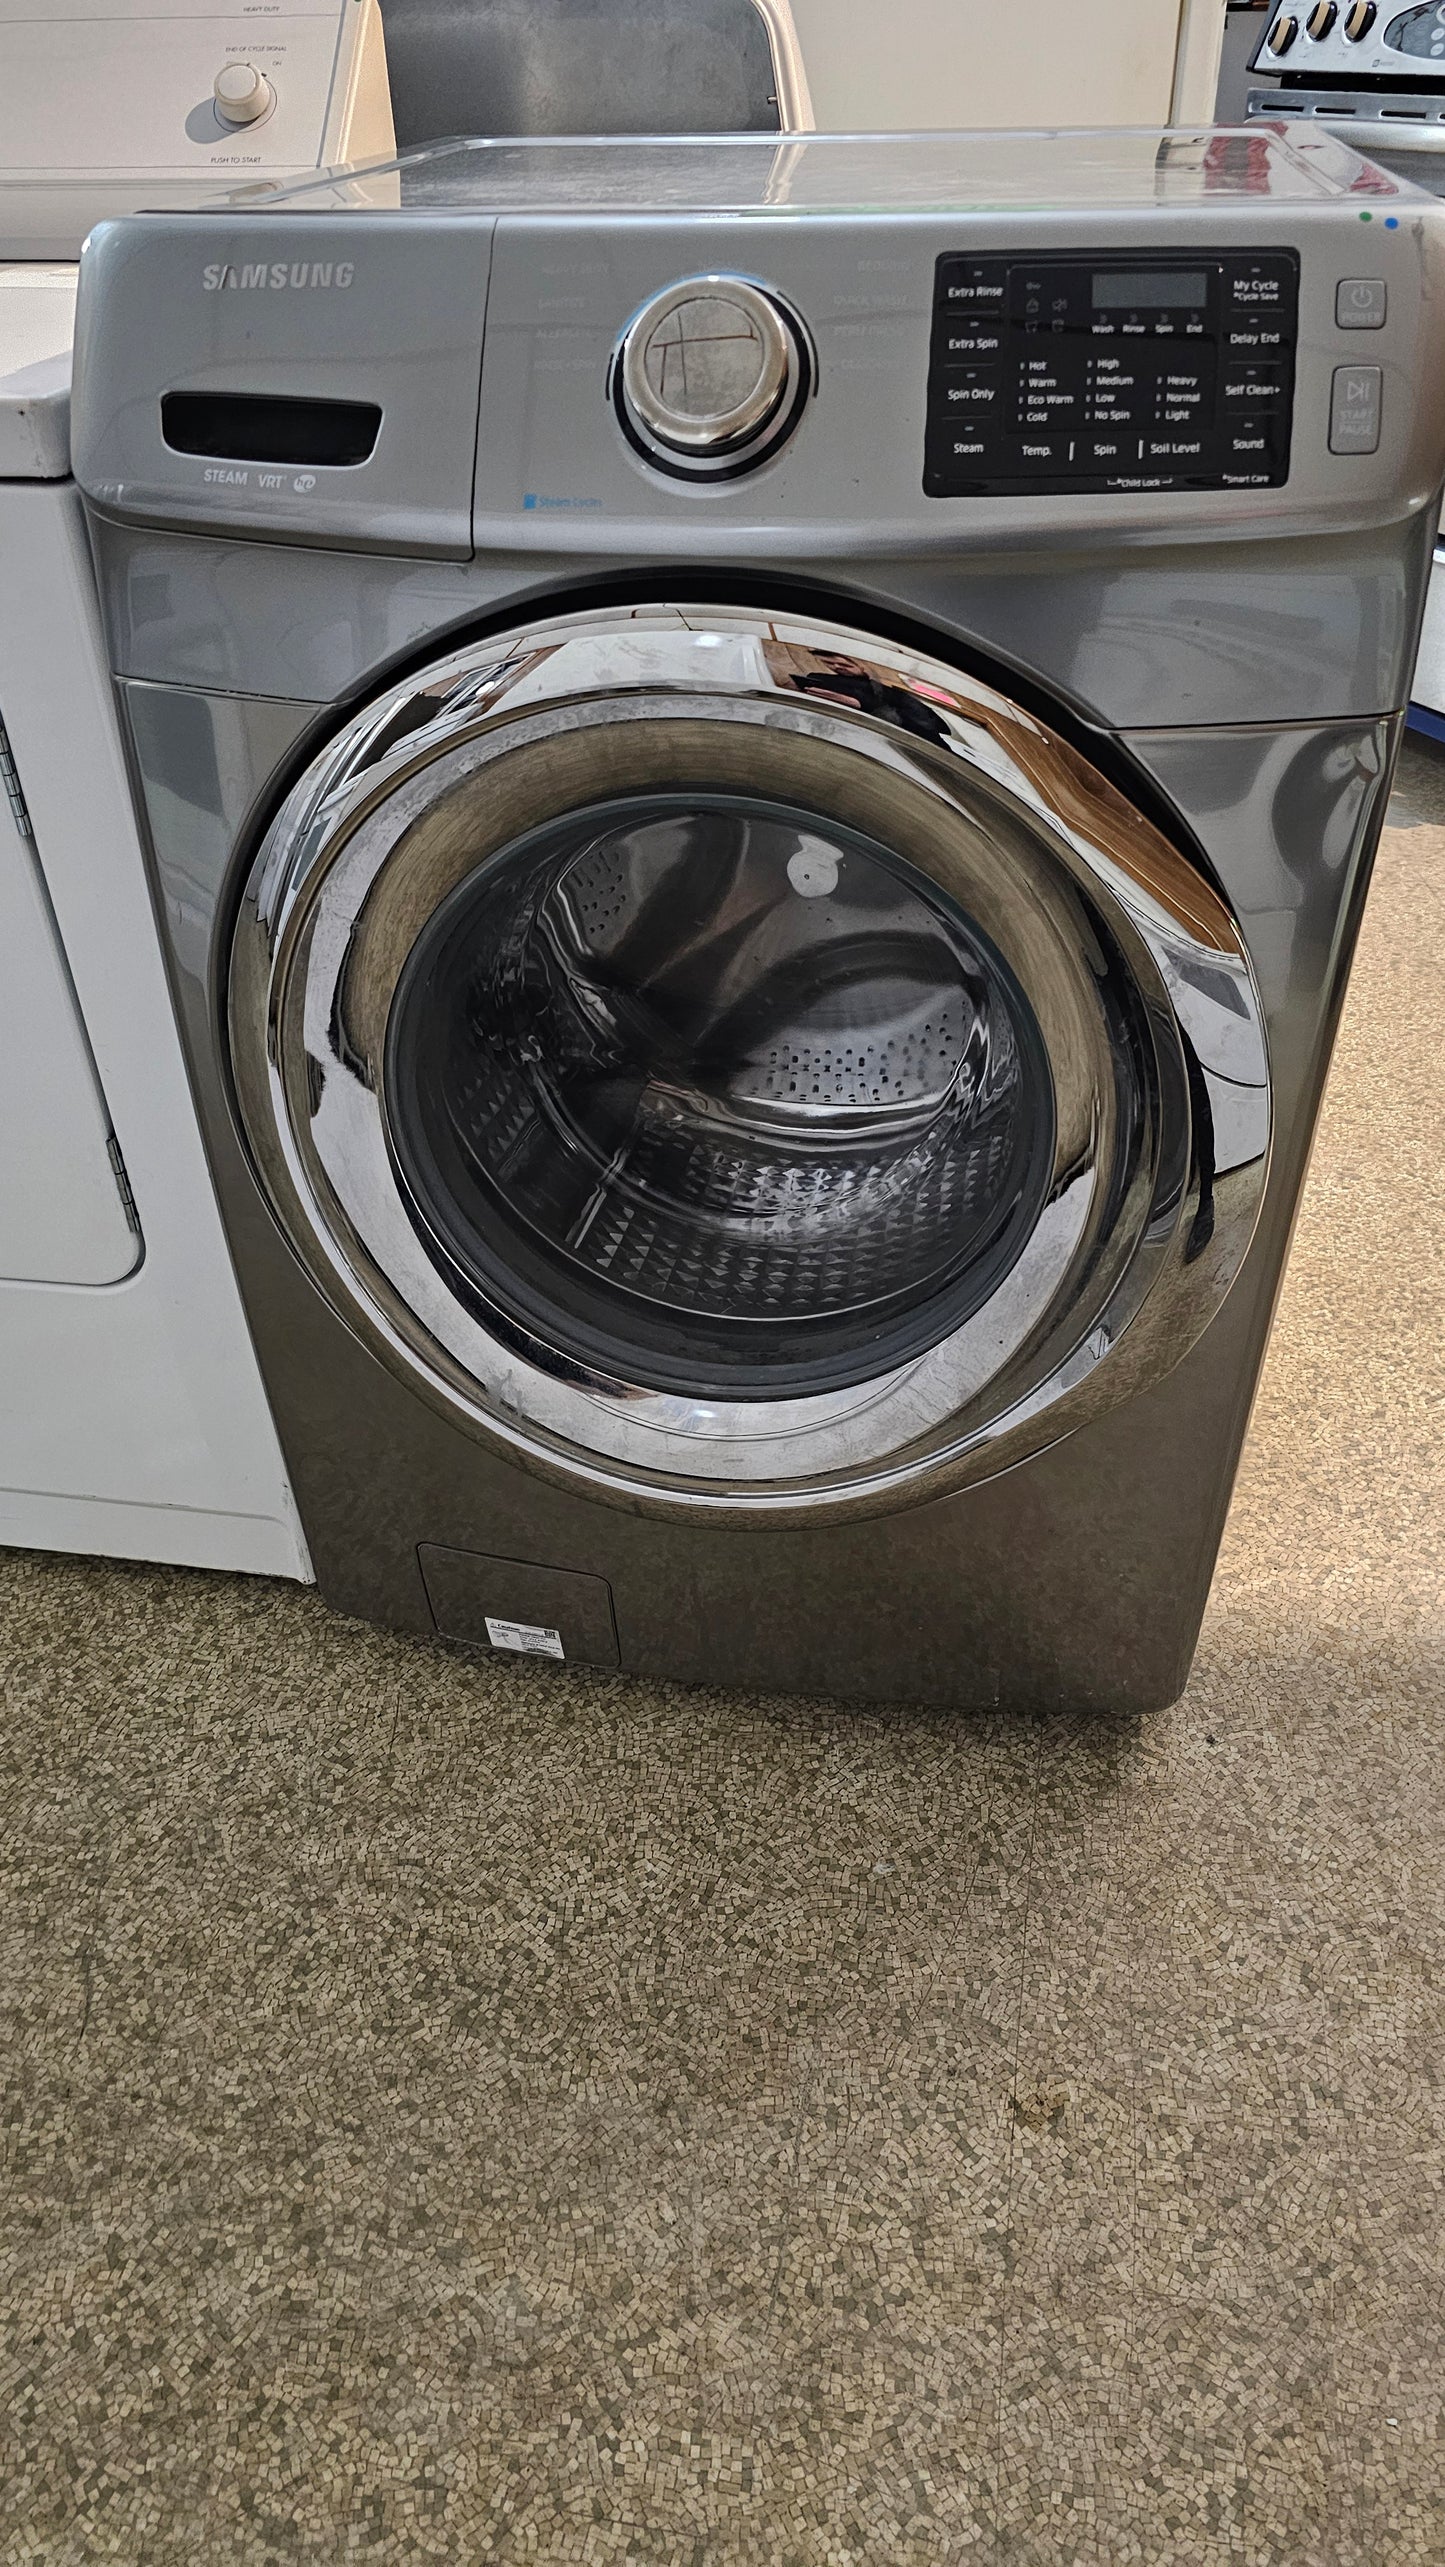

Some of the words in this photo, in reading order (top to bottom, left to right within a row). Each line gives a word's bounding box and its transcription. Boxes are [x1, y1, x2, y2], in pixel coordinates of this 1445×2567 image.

[202, 262, 354, 290] SAMSUNG
[1234, 280, 1249, 292] My
[1251, 280, 1279, 291] Cycle
[948, 287, 975, 298] Extra
[976, 286, 1003, 297] Rinse
[1092, 325, 1115, 334] Wash
[1122, 324, 1146, 333] Rinse
[1155, 324, 1174, 334] Spin
[1186, 324, 1203, 333] End
[948, 339, 975, 350] Extra
[976, 338, 998, 350] Spin
[1230, 333, 1258, 345] Delay
[1260, 333, 1280, 344] End
[1029, 361, 1048, 371] Hot
[1097, 358, 1120, 370] High
[1028, 378, 1057, 388] Warm
[1096, 376, 1134, 386] Medium
[1167, 376, 1198, 387] Heavy
[948, 389, 970, 401] Spin
[971, 388, 995, 401] Only
[1225, 385, 1245, 396] Self
[1027, 395, 1045, 405] Eco
[1046, 395, 1075, 404] Warm
[1095, 393, 1116, 403] Low
[1166, 392, 1200, 403] Normal
[1026, 412, 1048, 422] Cold
[1094, 410, 1109, 420] No
[1109, 410, 1131, 421] Spin
[1165, 410, 1190, 421] Light
[953, 442, 985, 454] Steam
[1150, 443, 1170, 454] Soil
[1171, 442, 1200, 454] Level
[1233, 438, 1265, 450] Sound
[1022, 445, 1052, 457] Temp.
[1093, 444, 1117, 456] Spin
[203, 468, 249, 485] STEAM
